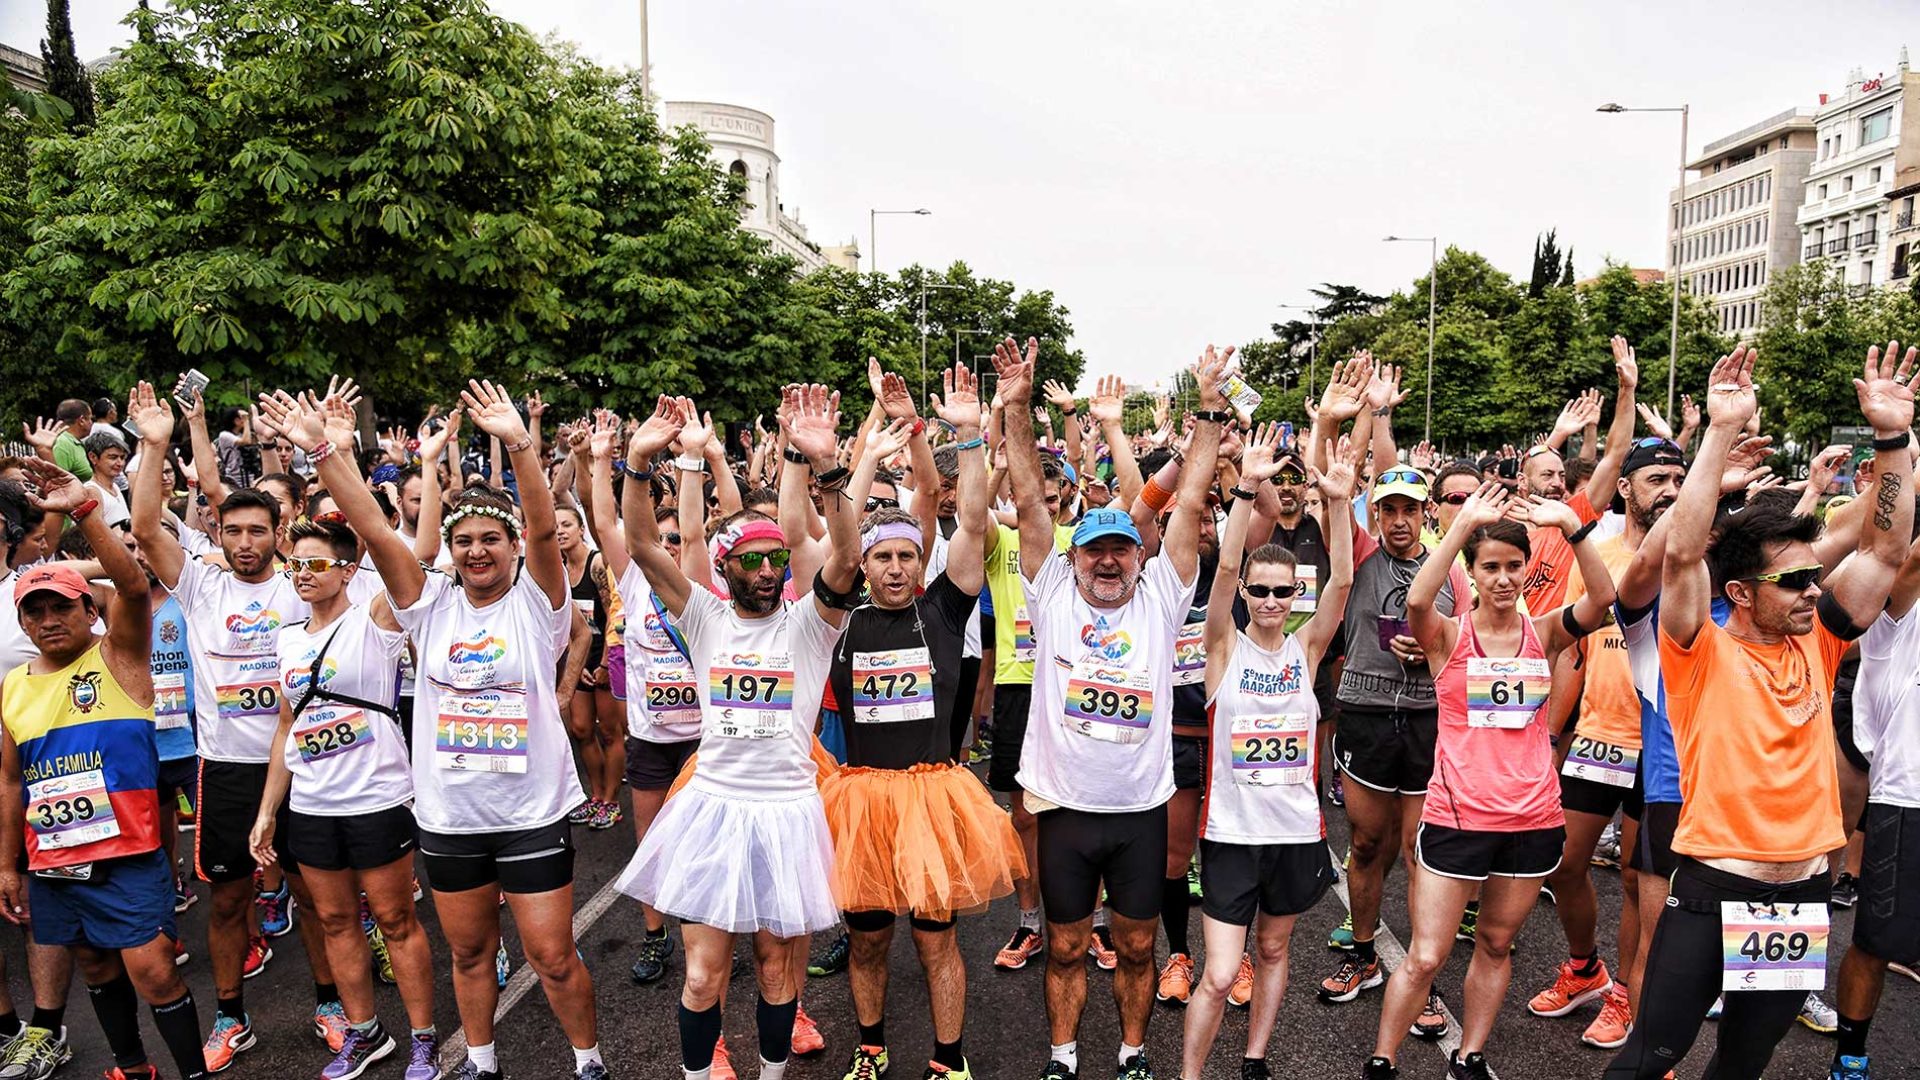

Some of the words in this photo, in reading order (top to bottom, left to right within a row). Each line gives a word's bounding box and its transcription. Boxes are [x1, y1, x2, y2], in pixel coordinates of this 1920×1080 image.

[150, 659, 189, 675] agena
[151, 650, 184, 662] thon
[239, 661, 278, 671] MADRID
[653, 655, 684, 664] MADRID
[722, 674, 779, 702] 197
[862, 672, 919, 699] 472
[1240, 679, 1301, 694] MARATONA
[1255, 672, 1284, 684] MEIA
[651, 687, 697, 705] 290
[1080, 687, 1139, 720] 393
[1491, 681, 1524, 705] 61
[304, 722, 357, 756] 528
[446, 719, 519, 750] 1313
[723, 726, 738, 736] 197
[1245, 737, 1299, 762] 235
[1576, 738, 1625, 765] 205
[38, 759, 55, 779] LA
[55, 750, 104, 776] FAMILIA
[37, 796, 95, 829] 339
[1740, 931, 1810, 962] 469
